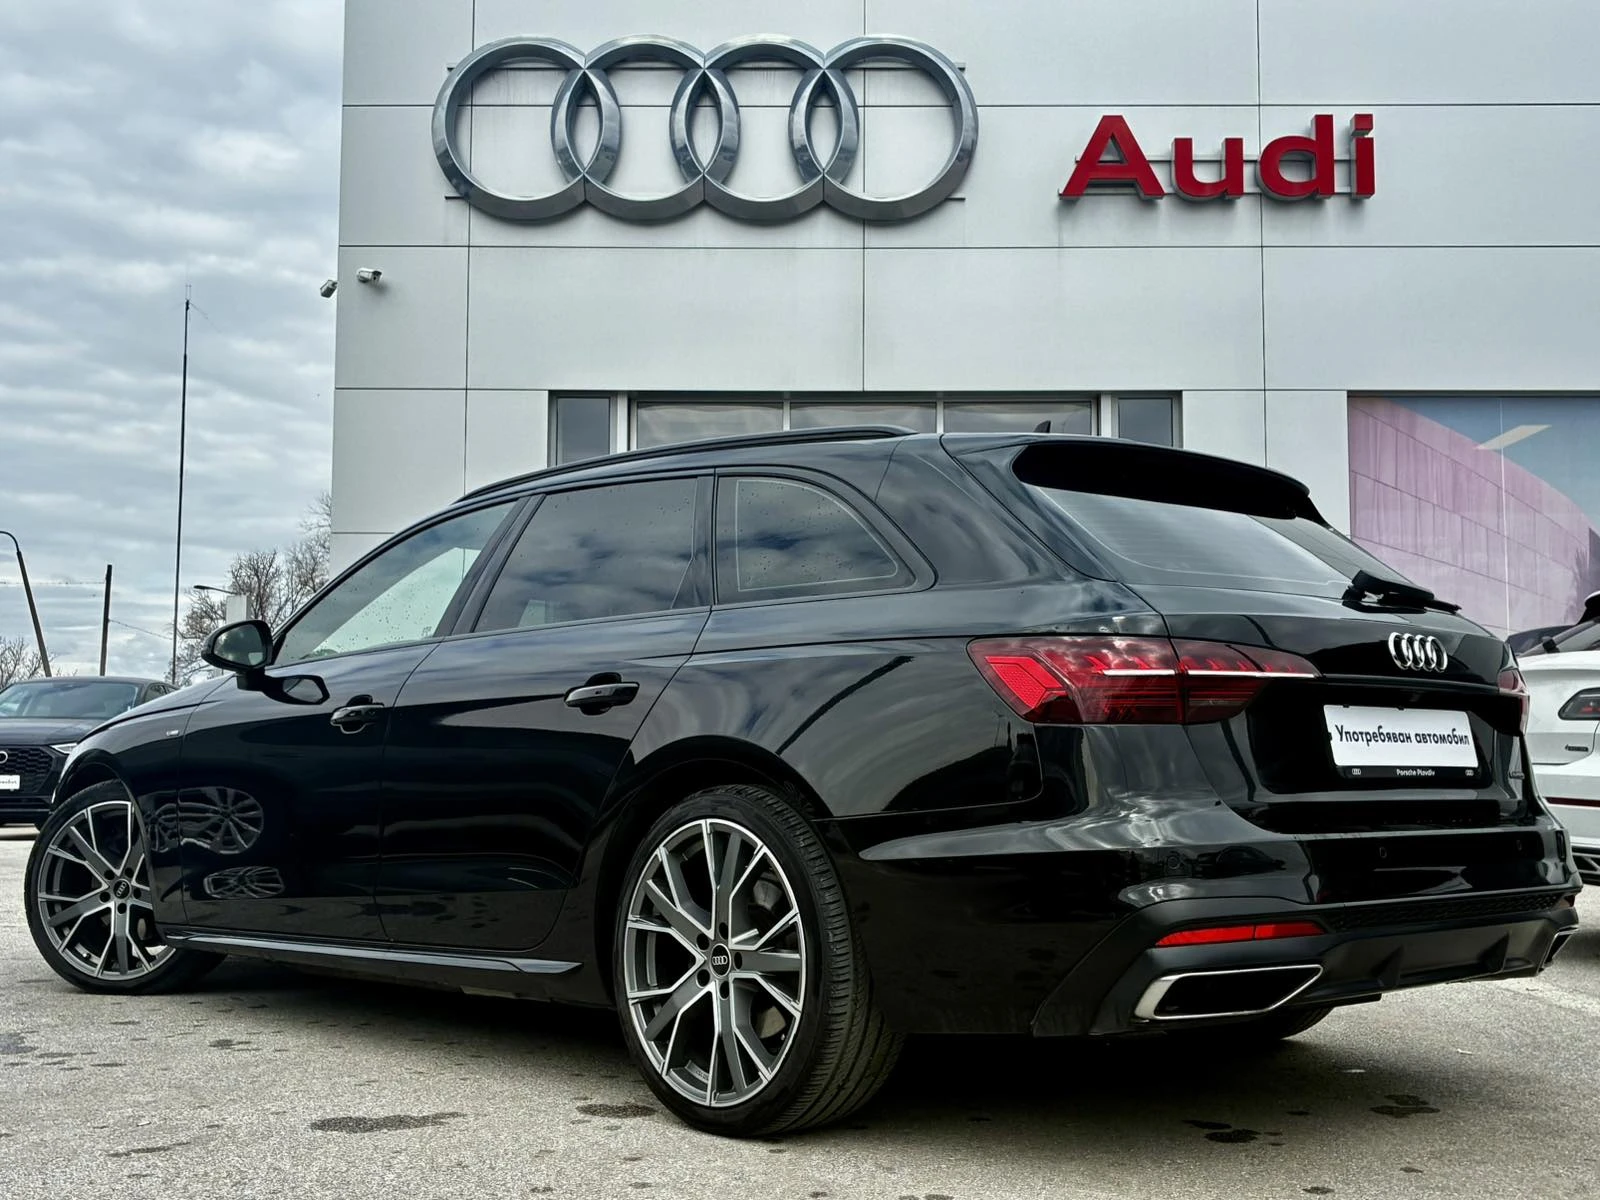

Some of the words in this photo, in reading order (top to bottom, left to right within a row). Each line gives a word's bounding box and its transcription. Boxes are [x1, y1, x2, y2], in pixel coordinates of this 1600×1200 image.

[1059, 114, 1375, 199] Audi
[1335, 724, 1413, 747] Употребяван
[1414, 728, 1470, 746] автомобил
